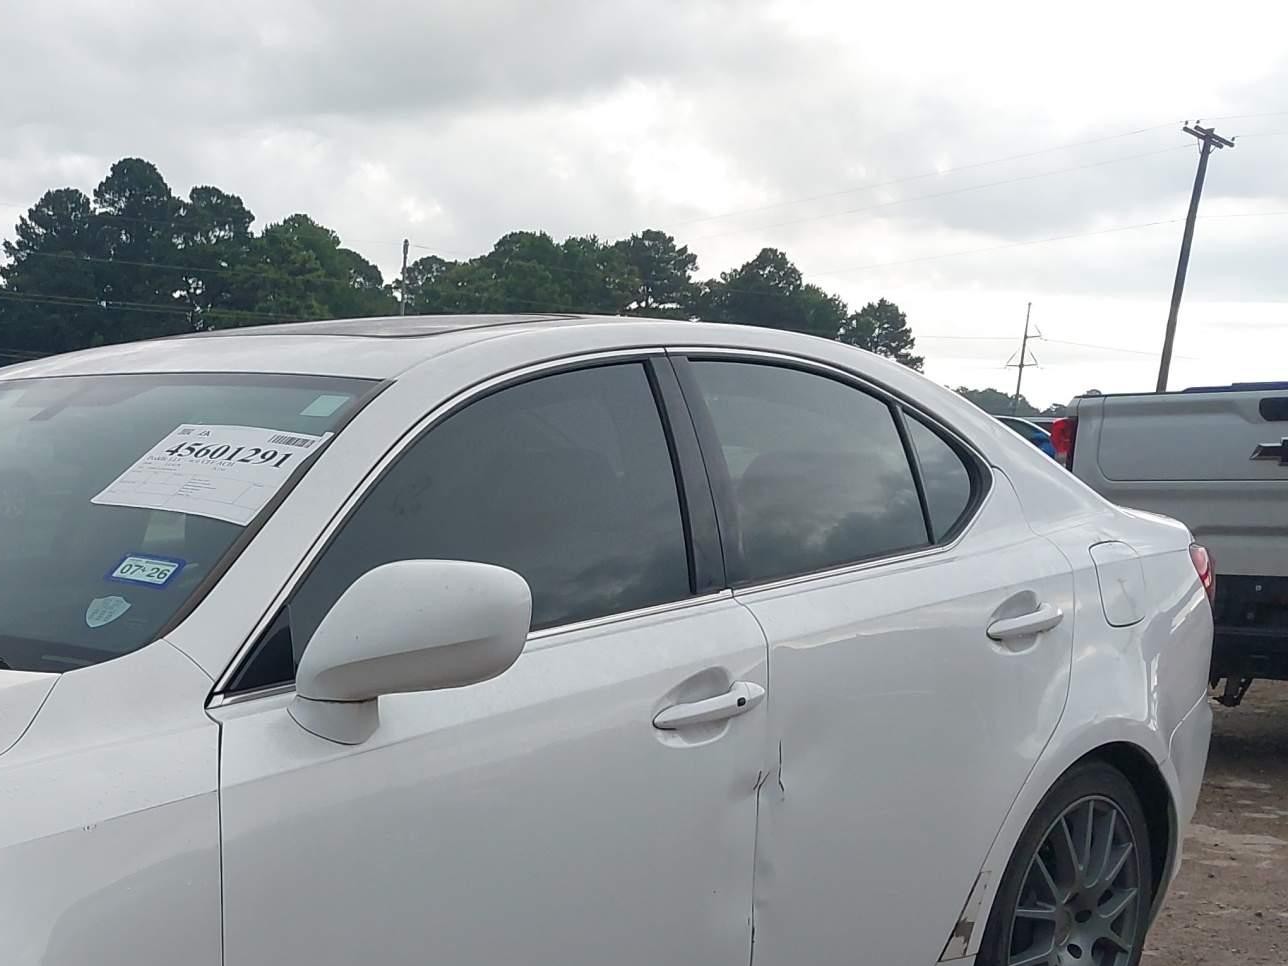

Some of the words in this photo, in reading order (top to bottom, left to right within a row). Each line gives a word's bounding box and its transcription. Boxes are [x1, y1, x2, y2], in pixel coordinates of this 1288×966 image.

[165, 442, 293, 468] 45601291
[120, 564, 143, 575] 07
[146, 567, 170, 579] 26
